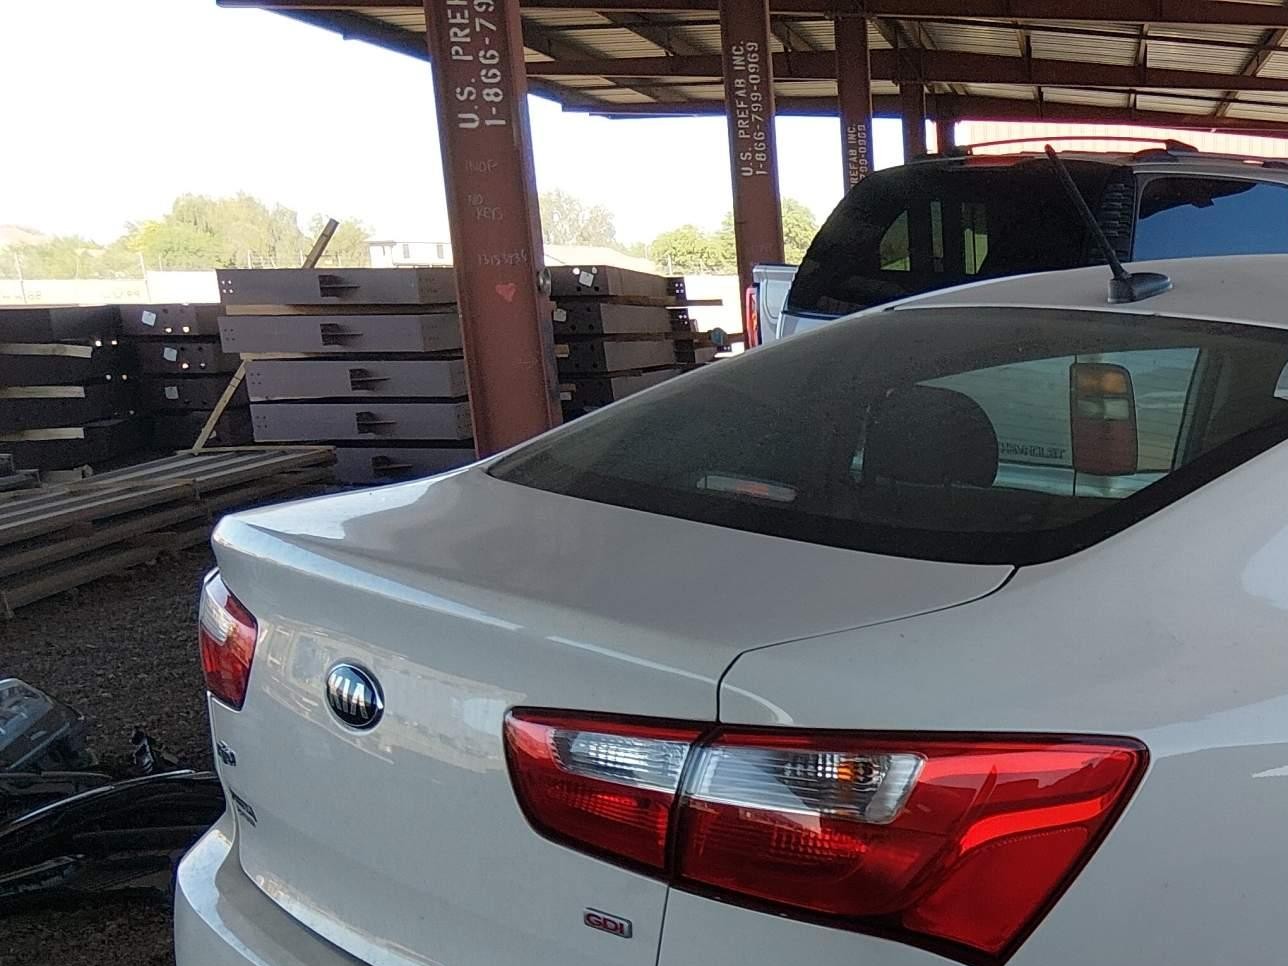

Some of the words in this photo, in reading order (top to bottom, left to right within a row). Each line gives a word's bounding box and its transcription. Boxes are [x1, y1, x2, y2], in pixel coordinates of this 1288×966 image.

[732, 40, 747, 70] INC.
[456, 77, 480, 128] U.S.
[734, 78, 751, 139] PREFAB
[747, 42, 768, 175] 1-866-799-0969
[740, 147, 754, 177] U.S.
[848, 149, 859, 189] REFAB
[327, 671, 370, 720] KIA
[586, 912, 625, 935] GDI
